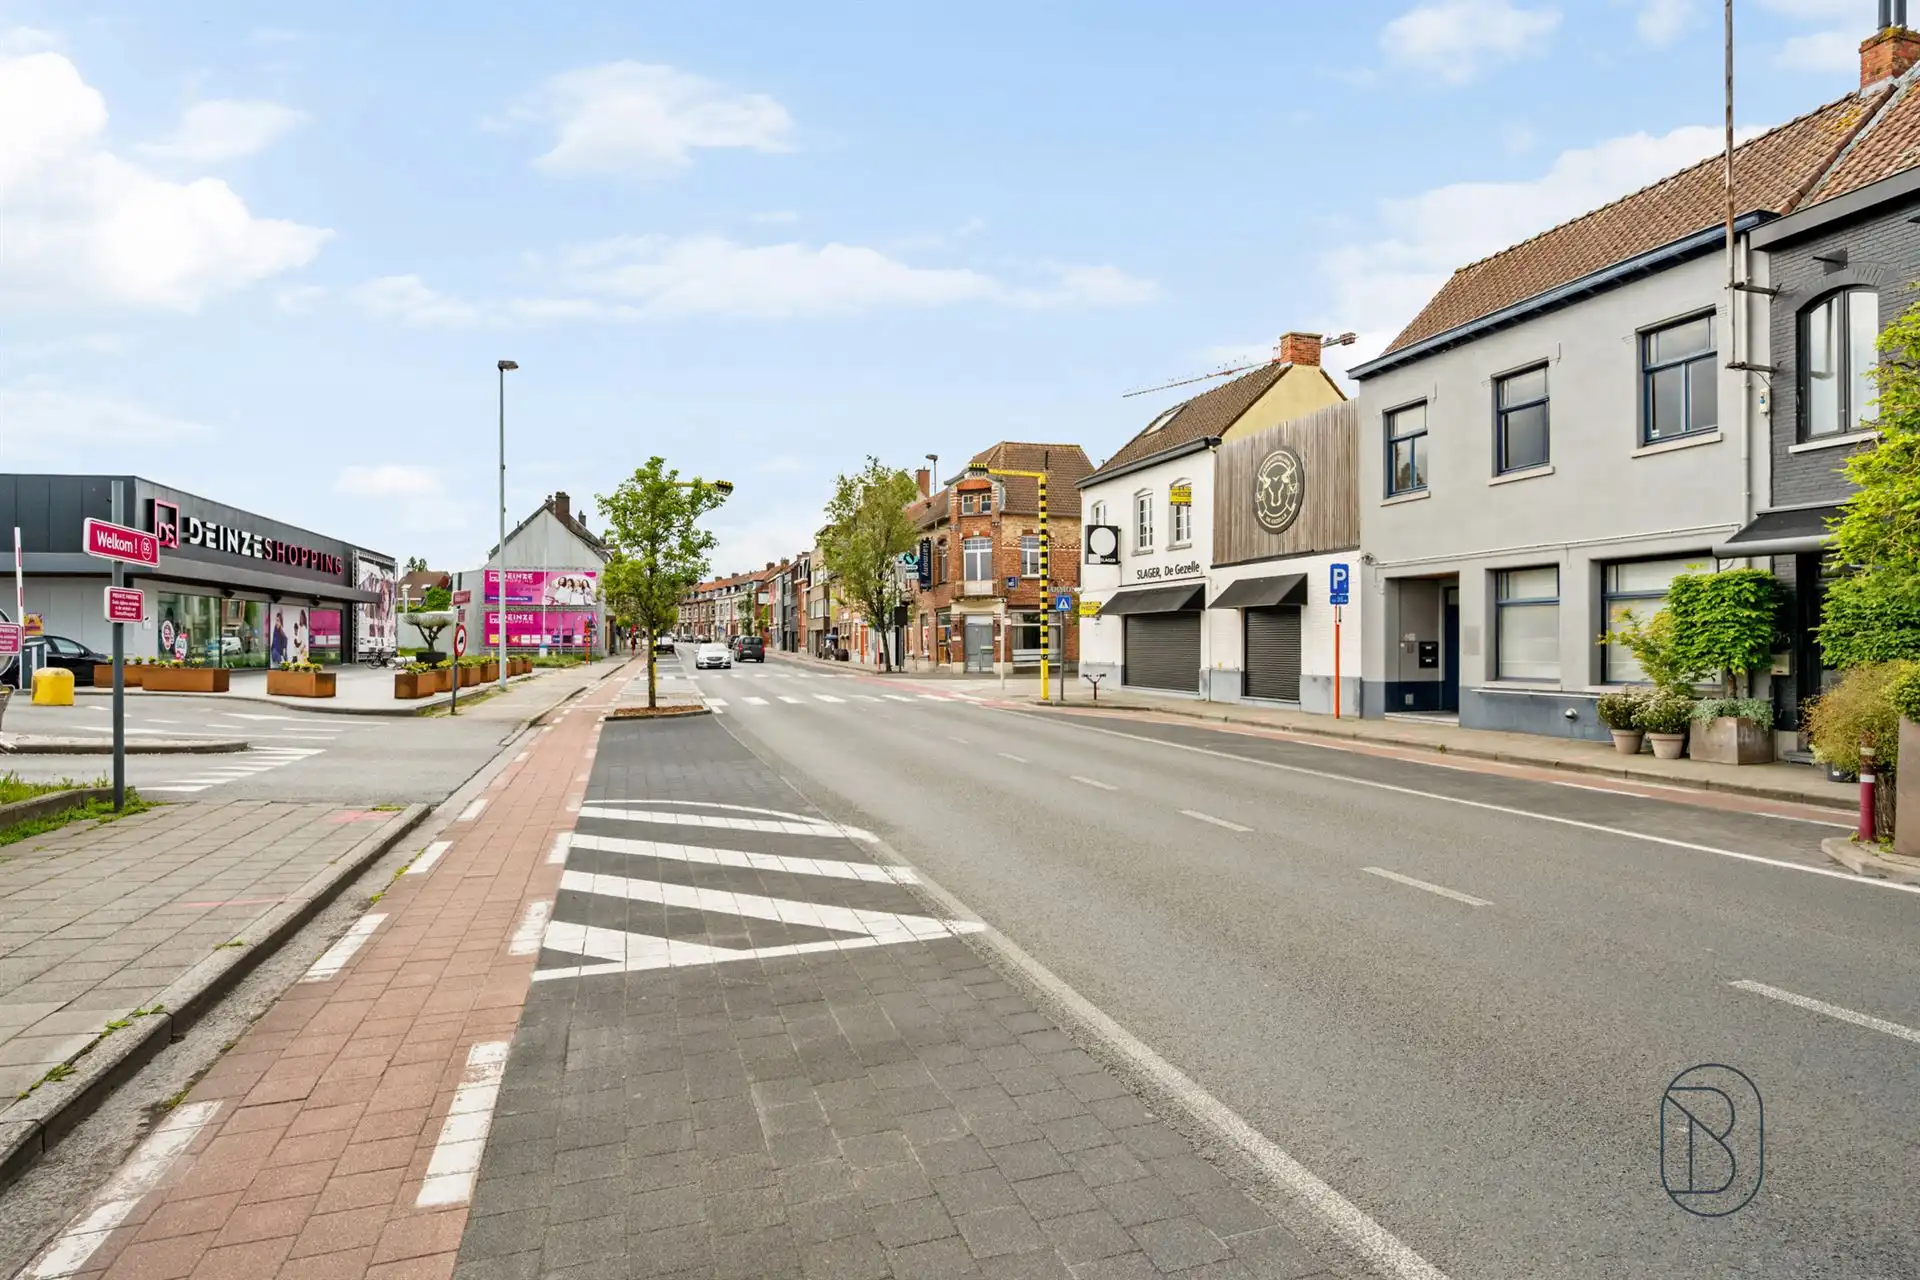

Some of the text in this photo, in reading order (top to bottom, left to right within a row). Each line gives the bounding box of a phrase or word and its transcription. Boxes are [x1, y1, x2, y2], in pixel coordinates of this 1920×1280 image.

[96, 530, 134, 554] Welkom
[922, 542, 930, 577] Harmony
[1137, 561, 1200, 580] SLAGER, De Gezelle
[1333, 568, 1347, 590] P
